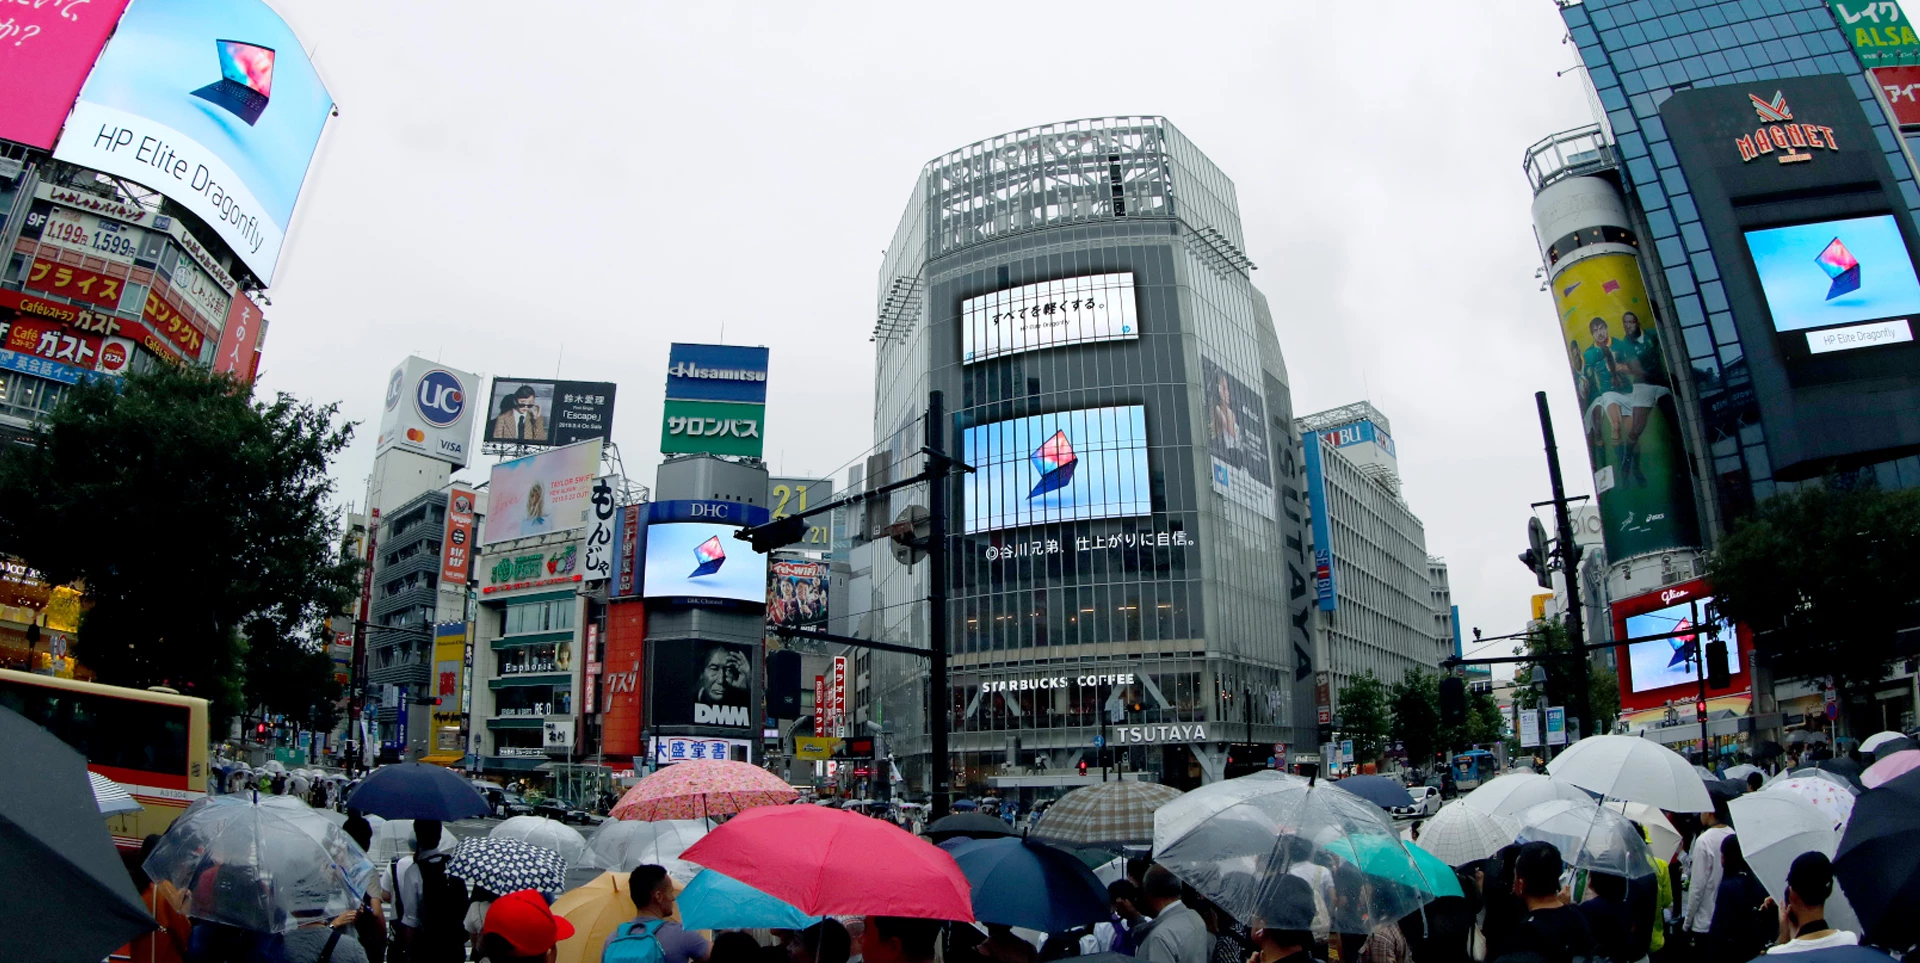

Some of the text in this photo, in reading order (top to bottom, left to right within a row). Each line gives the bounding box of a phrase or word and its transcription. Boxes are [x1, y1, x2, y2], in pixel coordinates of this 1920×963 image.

[1836, 2, 1899, 24] レイク
[1855, 26, 1920, 47] ALSA
[1735, 123, 1839, 162] MAGNET
[93, 123, 265, 255] HP Elite Dragonfly
[27, 212, 46, 227] 9F
[29, 262, 120, 300] プライス
[74, 309, 121, 335] ガスト
[144, 290, 200, 351] コンタクト
[991, 297, 1105, 326] すべてを軽くする。
[13, 326, 39, 342] Café
[1823, 333, 1837, 346] HP
[35, 330, 94, 363] ガスト
[103, 353, 124, 364] ガスト
[668, 361, 766, 382] Hisamitsu
[667, 415, 759, 439] サロンパス
[440, 440, 462, 453] VISA
[690, 502, 729, 519] DHC
[771, 484, 807, 520] 21
[585, 478, 614, 577] もんじゃ
[810, 525, 828, 545] 21
[1314, 548, 1332, 600] SEIBU
[1660, 588, 1689, 605] Glico
[504, 661, 552, 674] Euphoria
[982, 673, 1136, 693] STARBUCKS COFFEE
[694, 703, 751, 727] DMM
[1116, 724, 1206, 743] TSUTAYA
